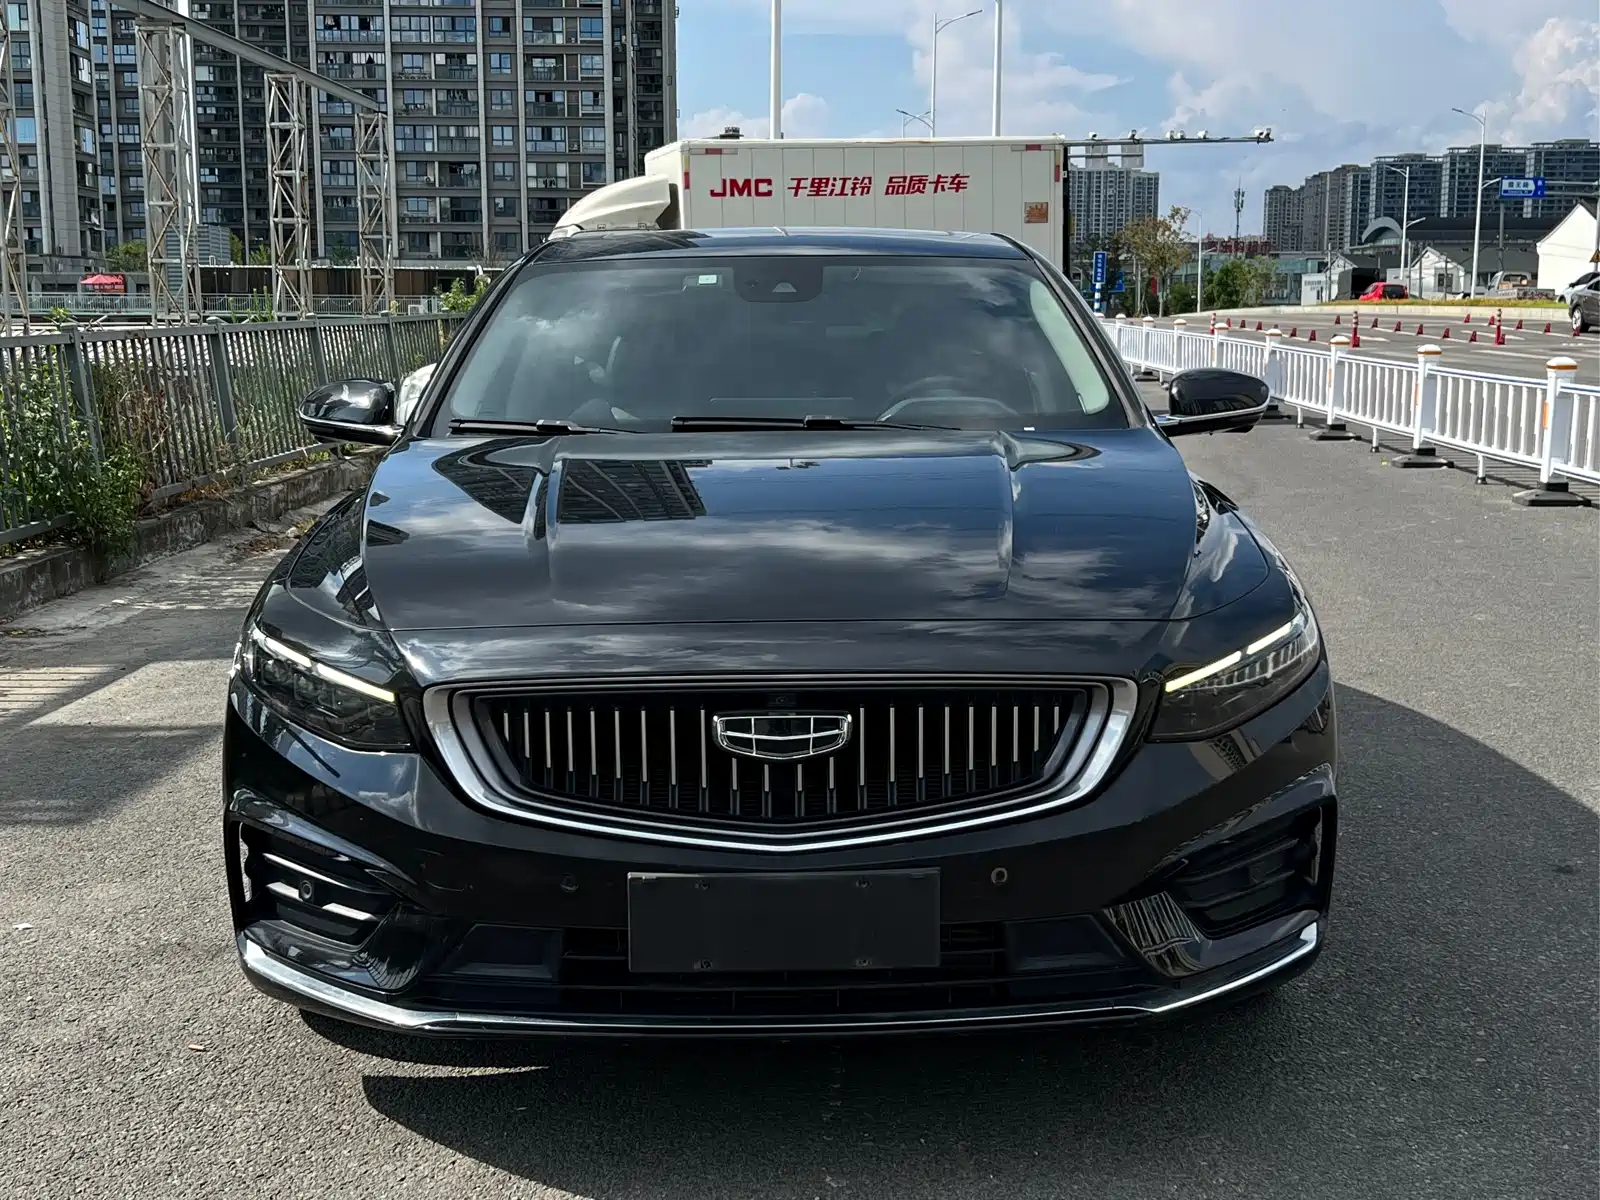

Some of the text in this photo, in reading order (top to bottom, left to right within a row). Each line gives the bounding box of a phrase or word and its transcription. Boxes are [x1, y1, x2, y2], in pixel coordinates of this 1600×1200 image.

[709, 178, 773, 198] JMC
[787, 174, 970, 197] 千里江铃 品质卡车
